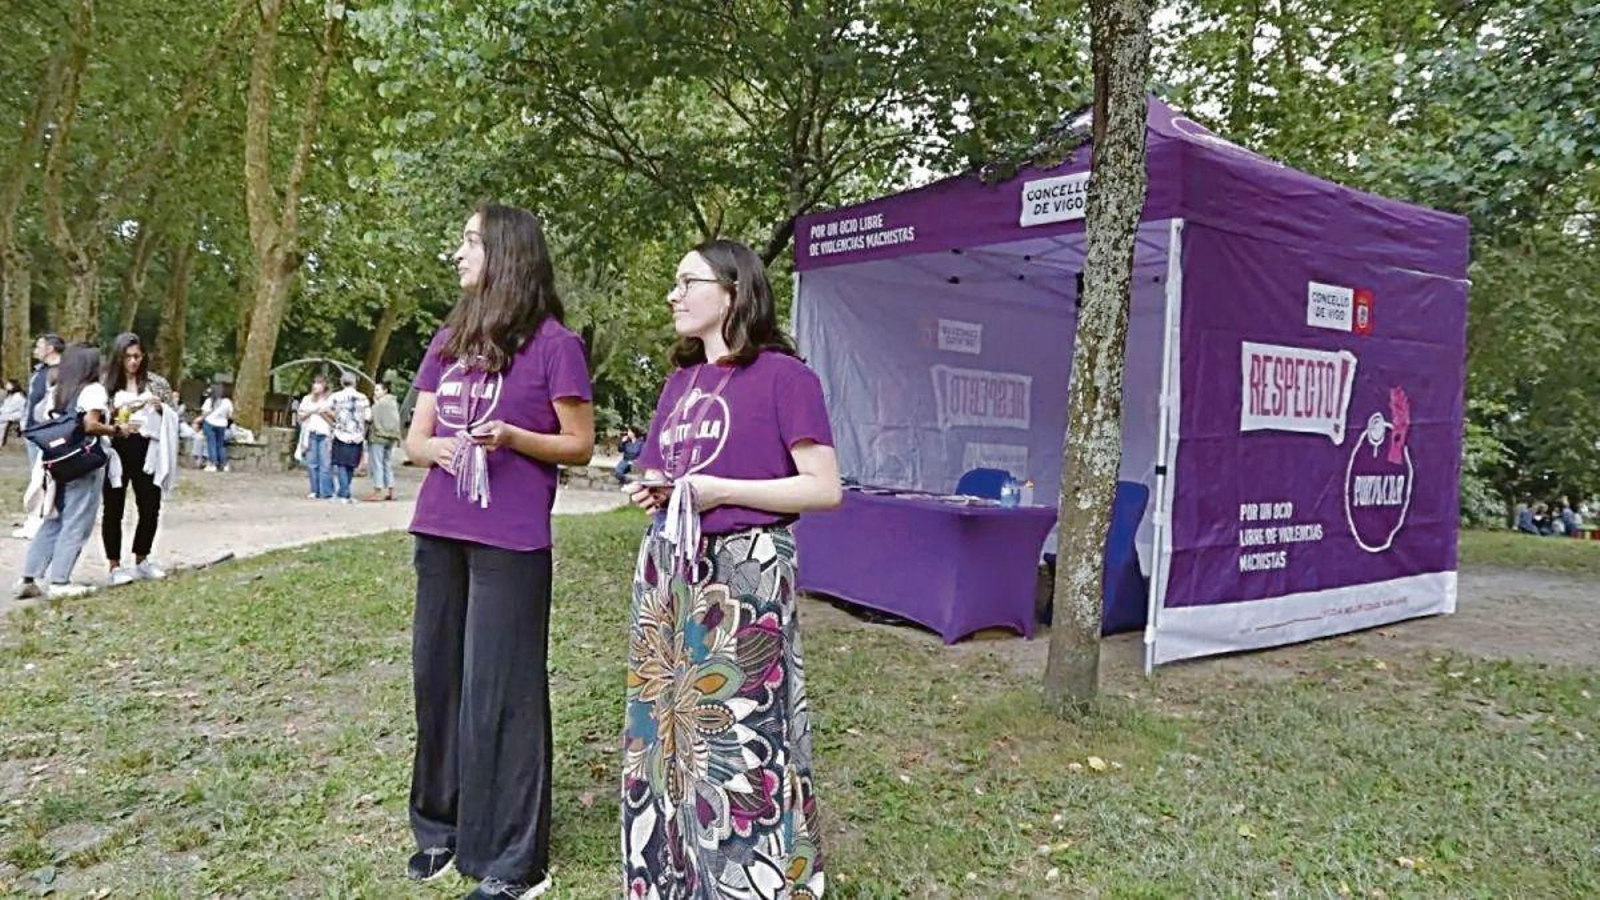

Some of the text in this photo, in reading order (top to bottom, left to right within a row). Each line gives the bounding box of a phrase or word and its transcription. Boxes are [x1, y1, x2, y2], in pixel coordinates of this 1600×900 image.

[1033, 197, 1083, 215] DE VIGO
[810, 214, 883, 239] POR UN OCIO LIBRE
[809, 227, 915, 256] DE VIOLENCIAS MACHISTAS
[1311, 291, 1350, 307] CONCELLO
[1315, 306, 1346, 321] DE VIGO
[1249, 353, 1351, 434] RESPECTO!
[1239, 502, 1293, 521] POR UN OCIO
[1239, 524, 1323, 547] LIBRE DE VIOLENCIAS
[1239, 550, 1287, 572] MACHISTAS
